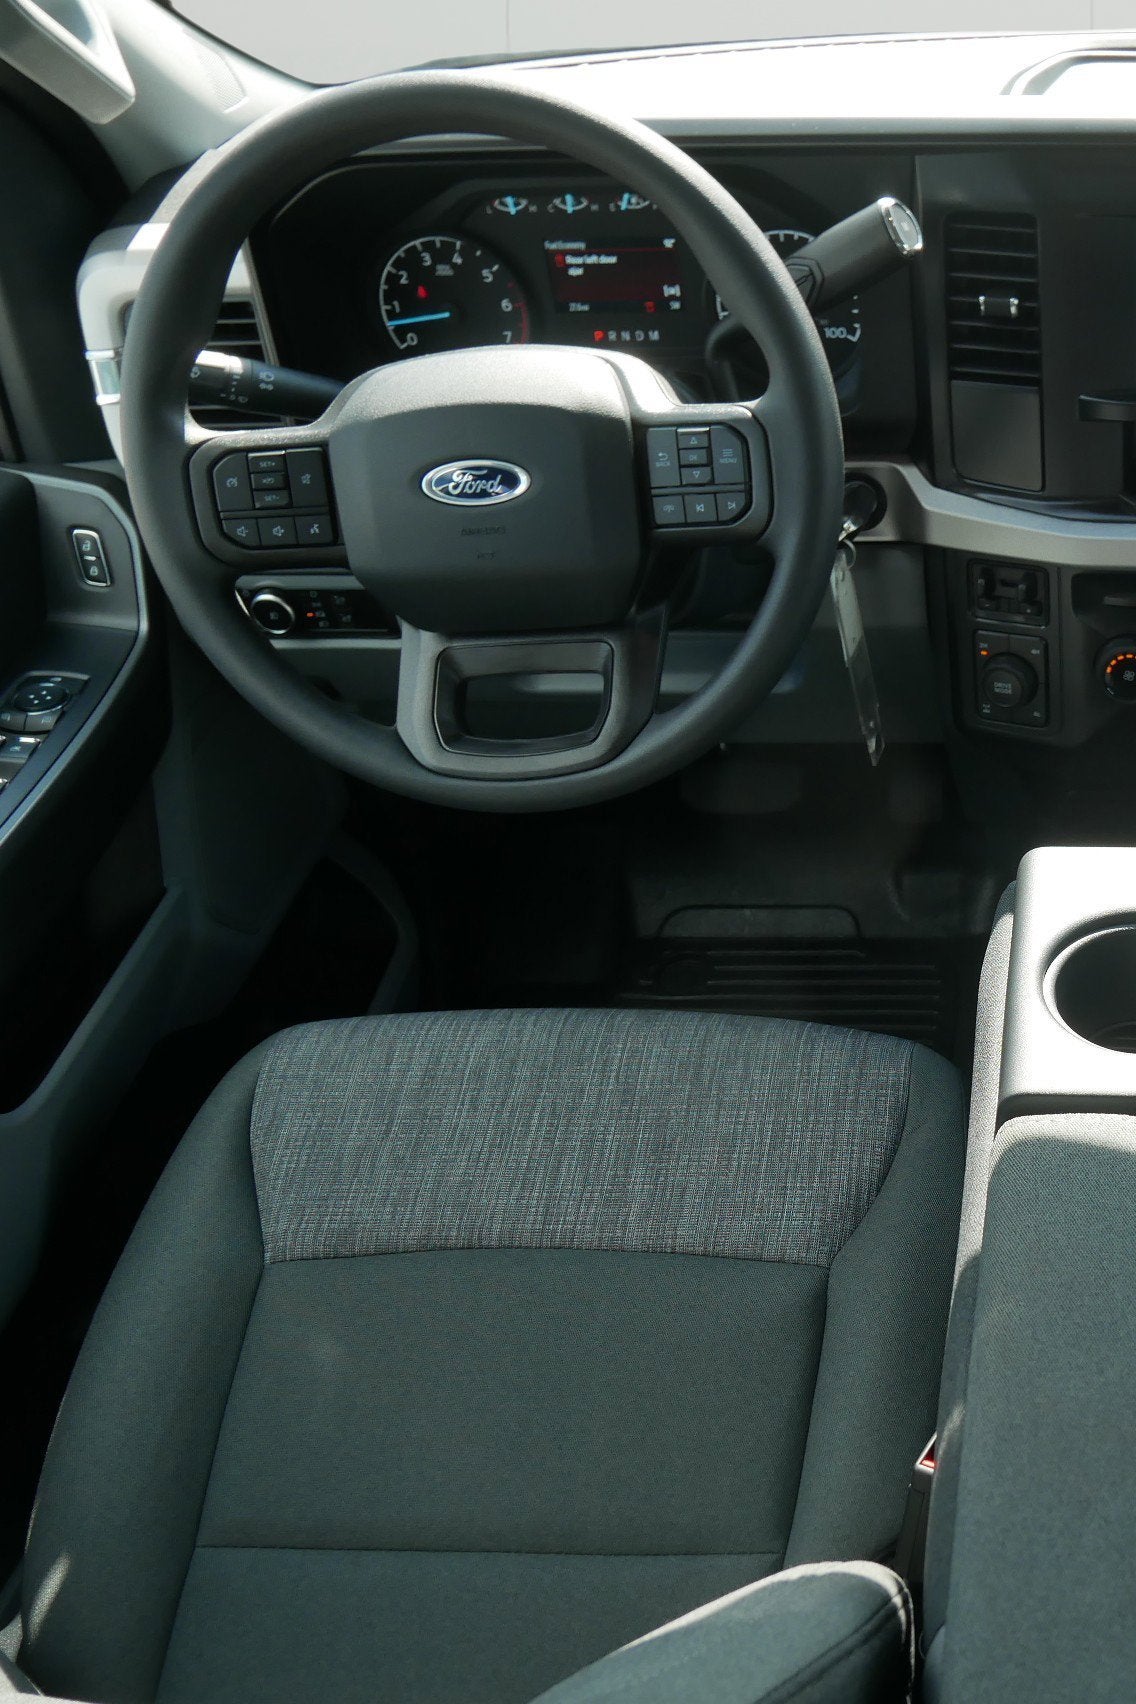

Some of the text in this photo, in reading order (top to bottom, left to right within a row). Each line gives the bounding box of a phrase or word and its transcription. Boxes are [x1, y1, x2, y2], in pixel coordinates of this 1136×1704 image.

[421, 252, 432, 267] 3
[452, 252, 463, 265] 4
[399, 270, 409, 285] 2
[481, 268, 494, 283] 5
[392, 300, 401, 314] 1
[501, 298, 513, 312] 6
[406, 332, 418, 346] 0
[502, 330, 512, 344] 7
[593, 329, 604, 342] P
[607, 330, 617, 342] R
[620, 330, 631, 342] N
[634, 330, 645, 342] D
[823, 326, 847, 340] 100
[446, 468, 503, 495] Ford
